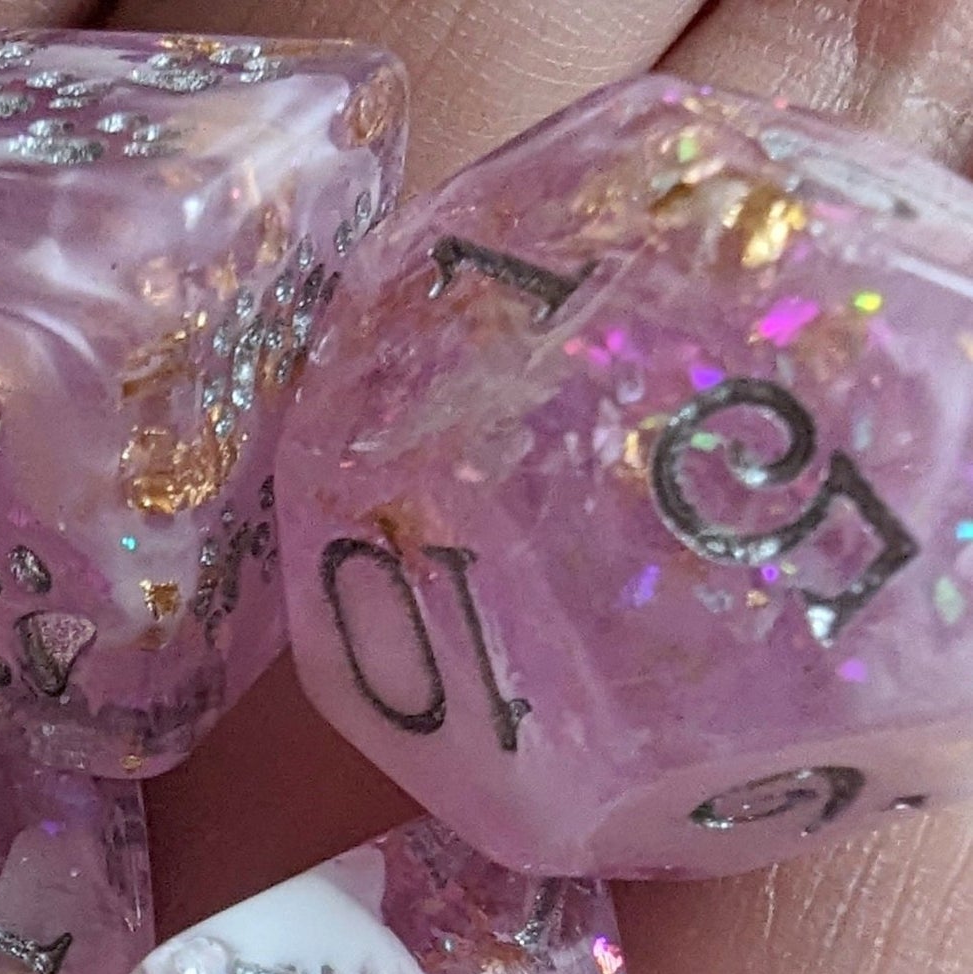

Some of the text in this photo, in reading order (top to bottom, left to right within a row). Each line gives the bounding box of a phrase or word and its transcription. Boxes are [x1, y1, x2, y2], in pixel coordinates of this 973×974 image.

[428, 233, 600, 328] 1
[649, 376, 919, 648] 5
[319, 536, 533, 752] 10
